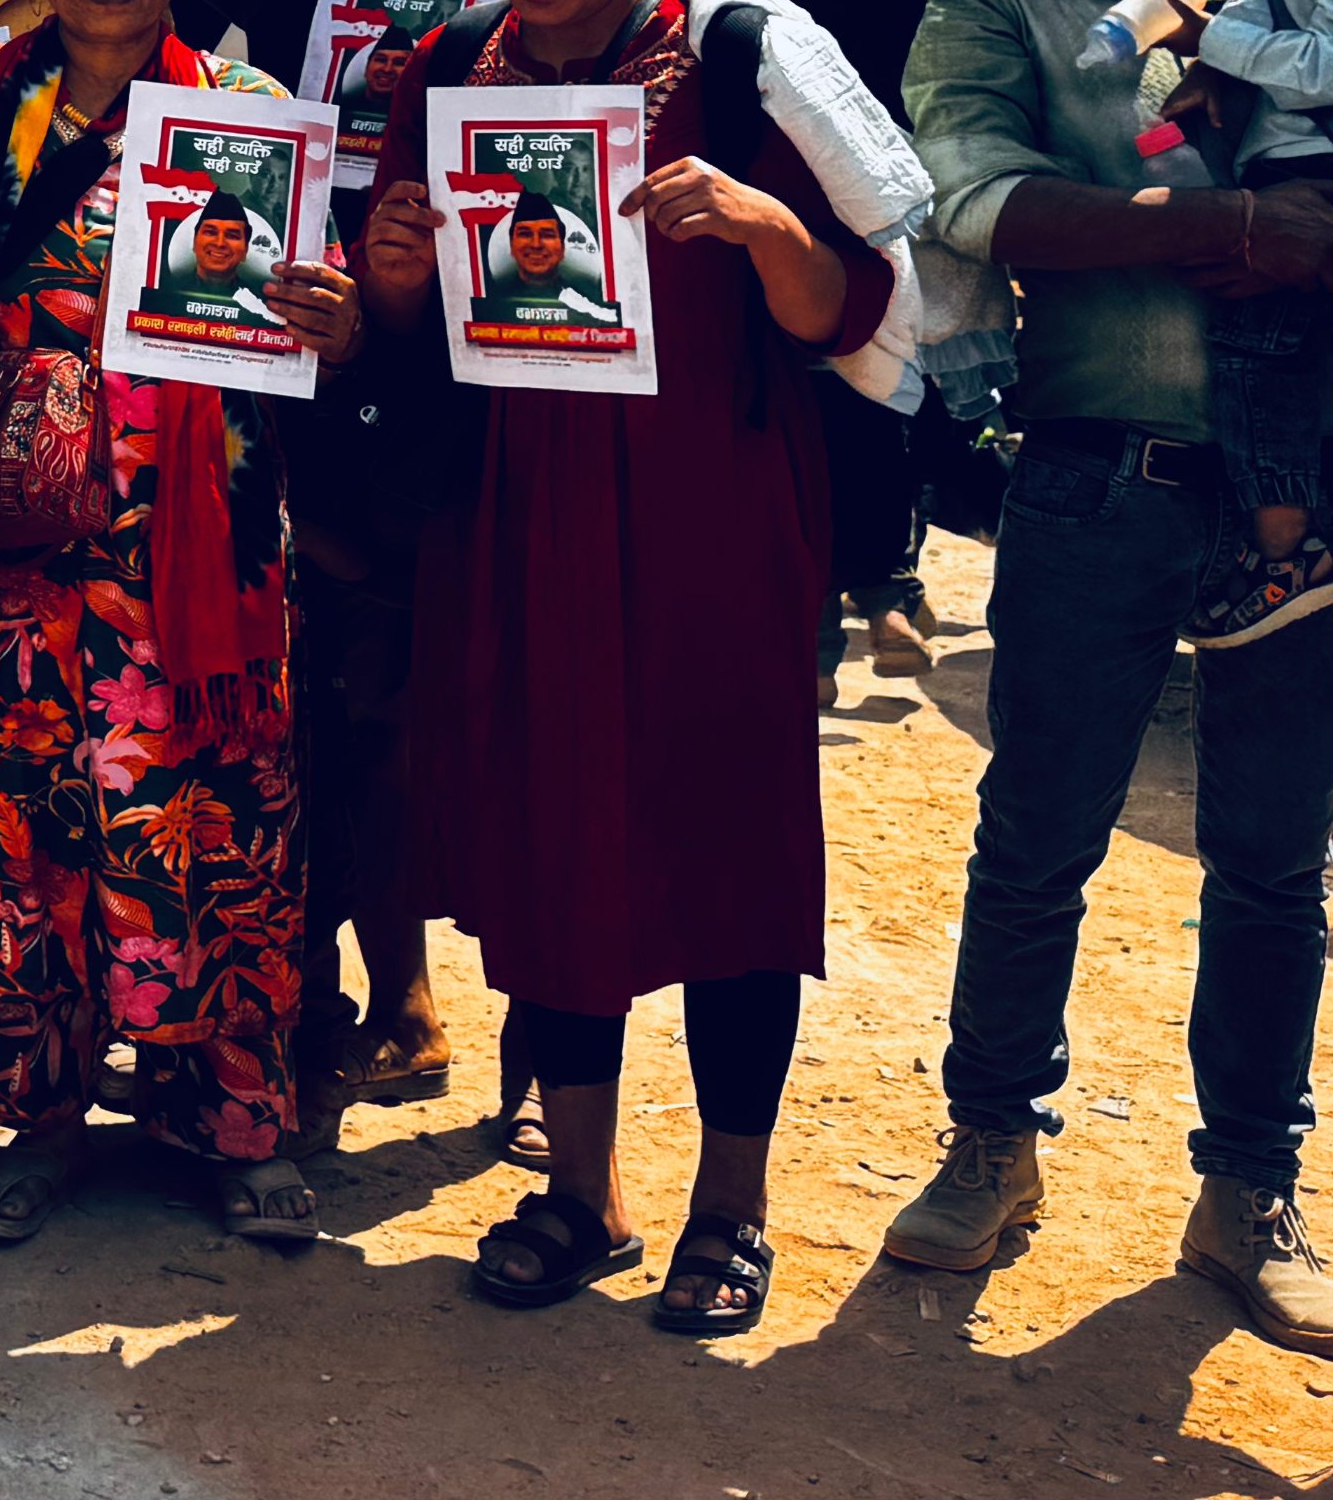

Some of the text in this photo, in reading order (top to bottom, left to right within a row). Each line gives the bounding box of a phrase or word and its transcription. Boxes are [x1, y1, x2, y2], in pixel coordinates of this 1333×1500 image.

[193, 136, 274, 159] सही व्यक्ति
[494, 135, 574, 153] सही व्यक्ति
[203, 157, 231, 174] सही
[506, 157, 533, 172] सही
